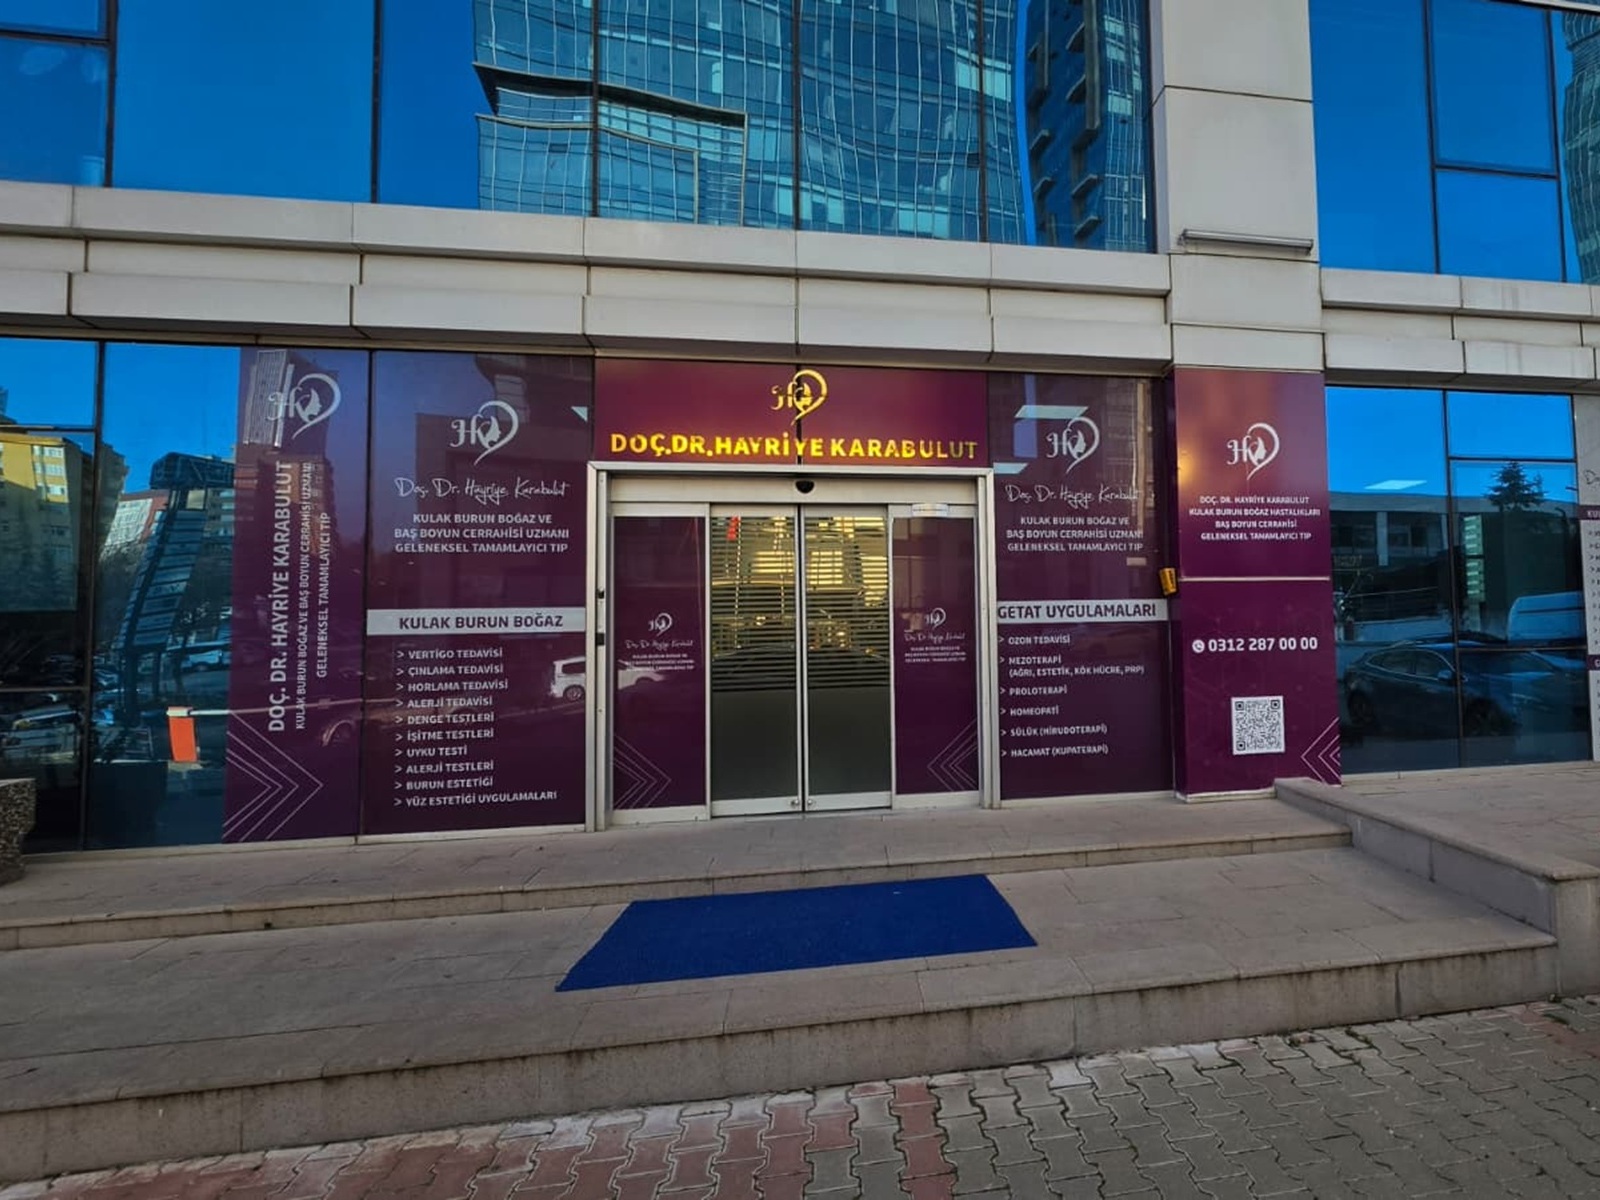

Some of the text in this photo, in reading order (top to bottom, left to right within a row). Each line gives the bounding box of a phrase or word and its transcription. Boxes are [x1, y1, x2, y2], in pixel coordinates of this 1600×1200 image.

[830, 437, 978, 460] KARABULUT
[301, 462, 312, 500] UZMANI
[413, 511, 552, 524] KULAK BURUN BOĞAZ VE
[1020, 516, 1050, 525] KULAK
[1053, 516, 1084, 525] BURUN
[1118, 516, 1130, 525] VE
[394, 526, 569, 541] BAŞ BOYUN CERRAHİSİ UZMANI
[1006, 530, 1024, 540] BAŞ
[1026, 530, 1058, 538] BOYUN
[395, 543, 568, 553] GELENEKSEL TAMAMLAYICI TIP
[1007, 543, 1065, 552] GELENEKSEL
[1128, 543, 1143, 551] TIP
[299, 554, 310, 588] BOYUN
[268, 461, 292, 731] DOÇ. DR. HAYRİYE KARABULUT
[299, 590, 310, 609] BAŞ
[317, 512, 330, 678] GELENEKSEL TAMAMLAYICI TIP
[299, 611, 308, 623] VE
[998, 604, 1156, 619] GETAT UYGULAMALARI
[400, 613, 563, 629] KULAK BURUN BOĞAZ
[297, 623, 308, 657] BOĞAZ
[1008, 634, 1071, 645] OZON TEDAVİSİ
[1208, 637, 1318, 651] 0312 287 00 00
[408, 647, 503, 659] VERTİGO TEDAVİSİ
[296, 660, 306, 695] BURUN
[408, 664, 504, 677] ÇINLAMA TEDAVİSİ
[408, 679, 508, 692] HORLAMA TEDAVİSİ
[407, 696, 492, 708] ALERJİ TEDAVİSİ
[296, 696, 306, 729] KULAK
[407, 712, 494, 725] DENGE TESTLERİ
[407, 728, 494, 742] İŞİTME TESTLERİ
[406, 745, 467, 757] UYKU TESTİ
[1011, 747, 1050, 757] HACAMAT
[406, 760, 494, 774] ALERJİ TESTLERİ
[406, 780, 444, 790] BURUN
[406, 796, 426, 807] YÜZ
[478, 790, 557, 804] UYGULAMALARI
